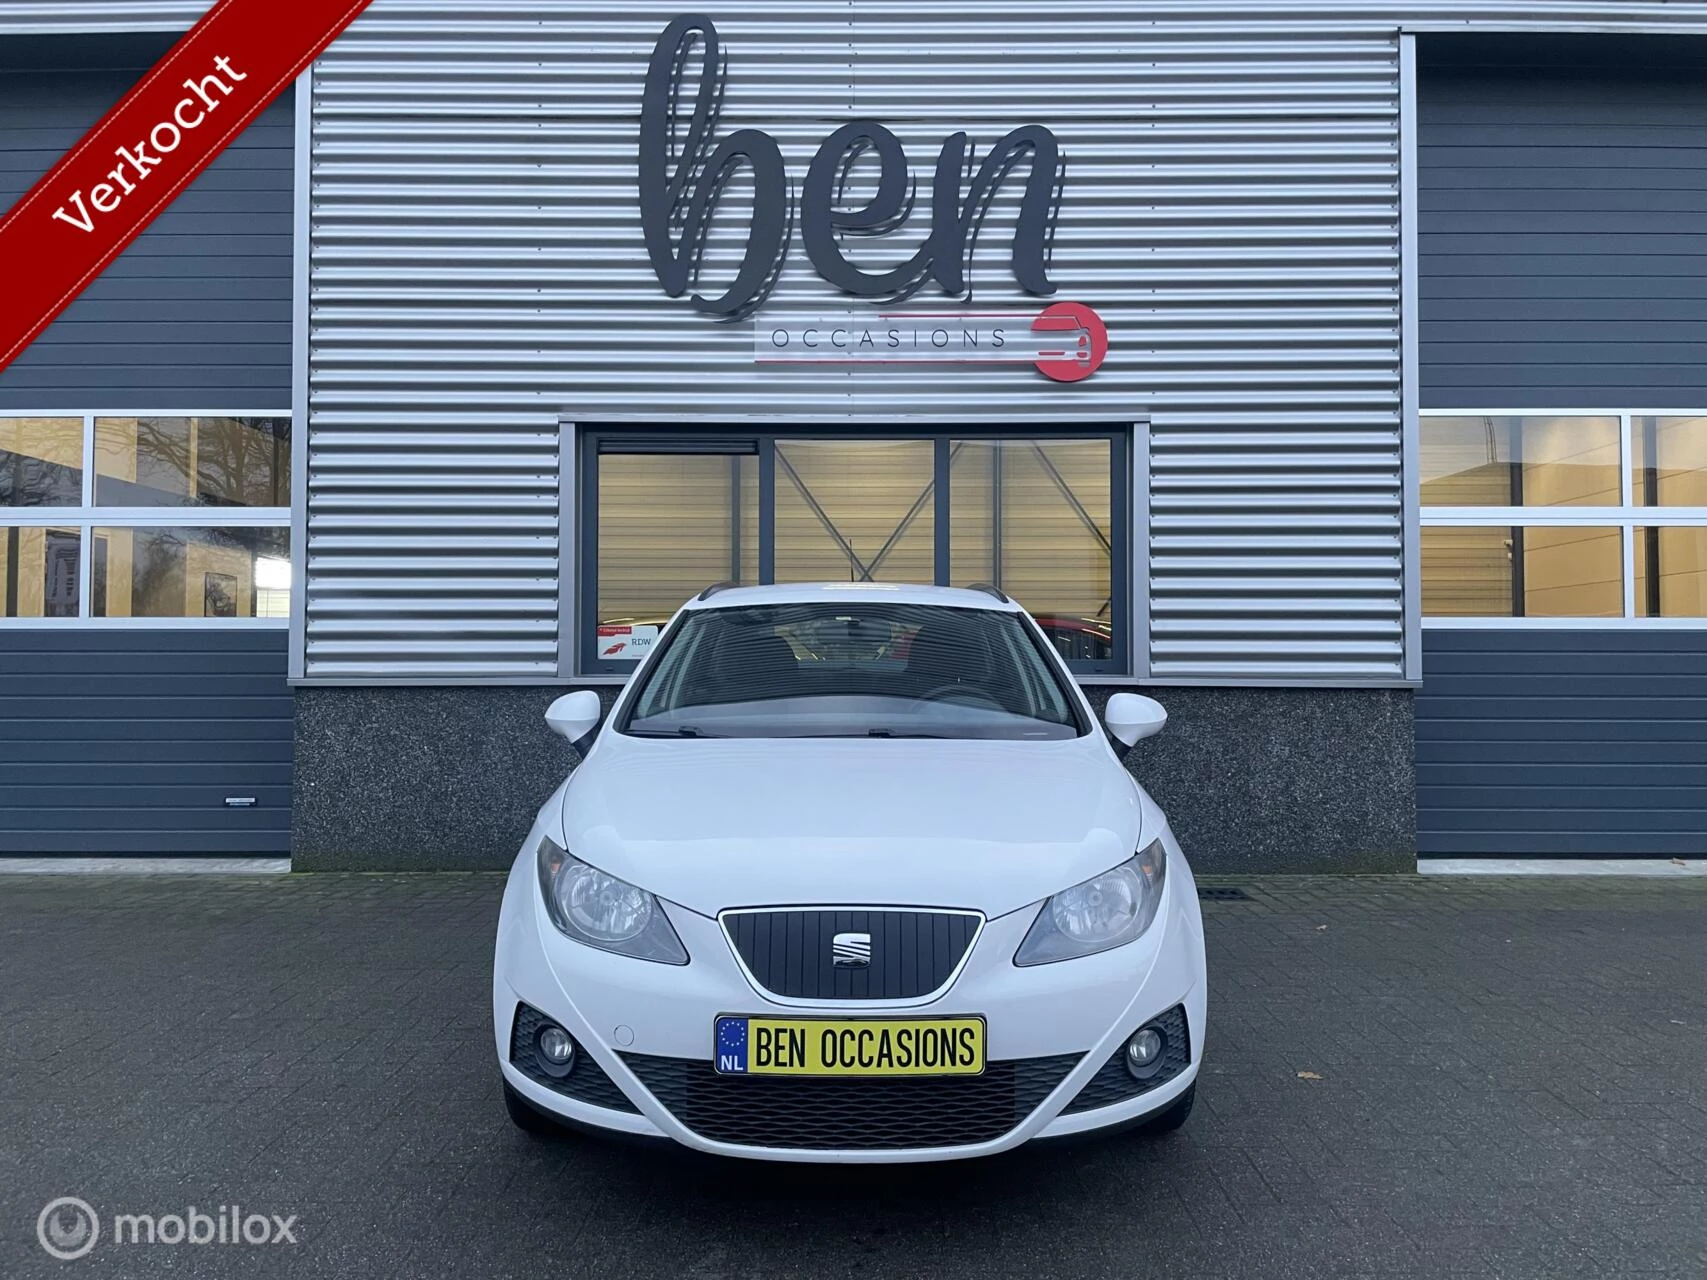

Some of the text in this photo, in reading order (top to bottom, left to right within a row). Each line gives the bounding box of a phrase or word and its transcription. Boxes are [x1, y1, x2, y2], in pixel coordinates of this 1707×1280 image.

[639, 13, 1062, 318] ben
[771, 328, 1006, 348] OCCASIONS
[631, 638, 651, 646] RDW
[755, 1027, 976, 1068] BEN OCCASIONS
[720, 1054, 744, 1071] NL
